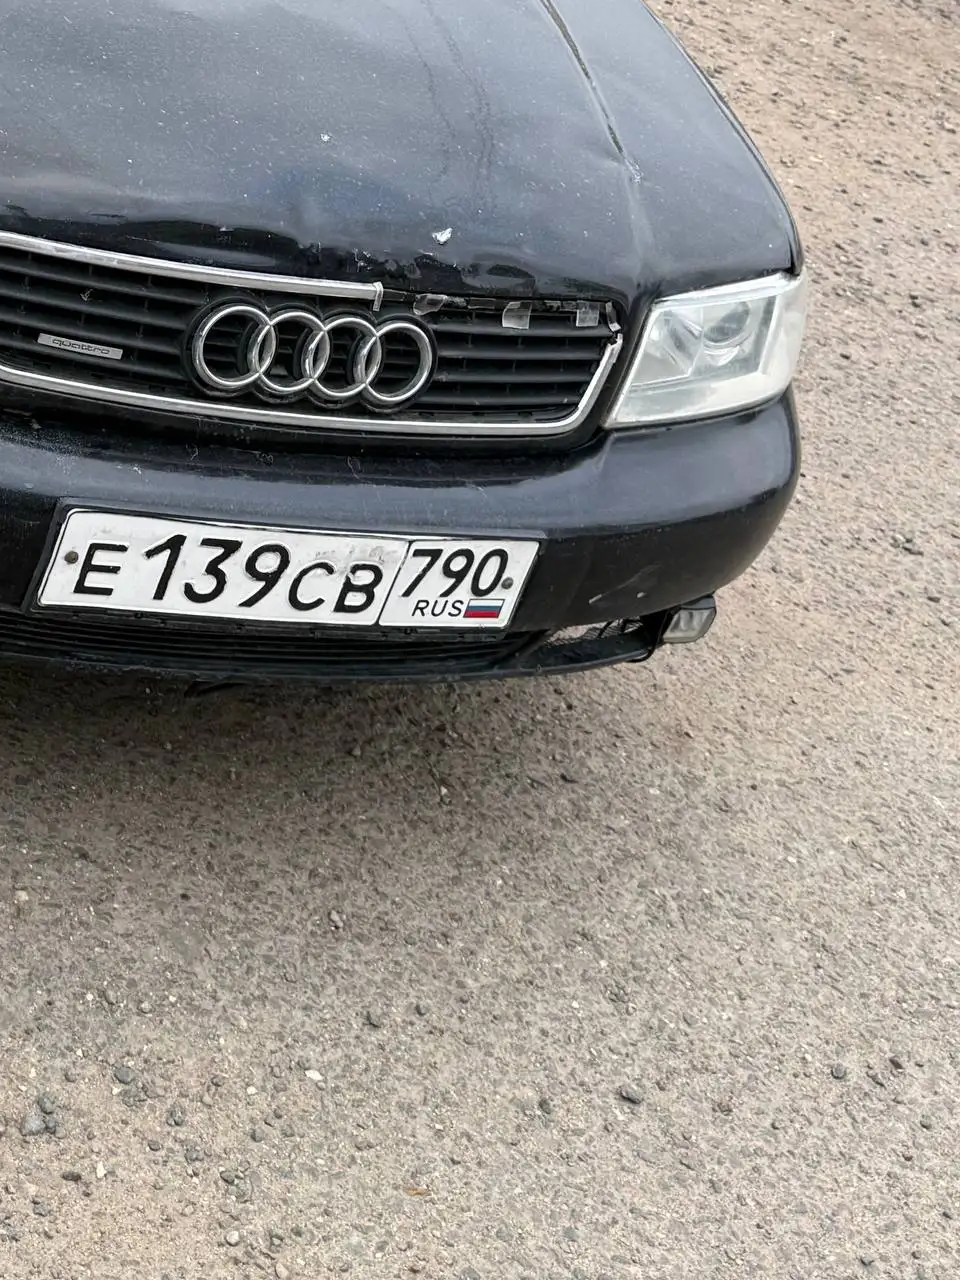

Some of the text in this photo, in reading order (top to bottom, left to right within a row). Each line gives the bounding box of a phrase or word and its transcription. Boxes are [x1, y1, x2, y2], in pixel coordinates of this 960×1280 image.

[52, 338, 110, 355] quattro
[401, 548, 508, 598] 790
[411, 599, 464, 618] RUS
